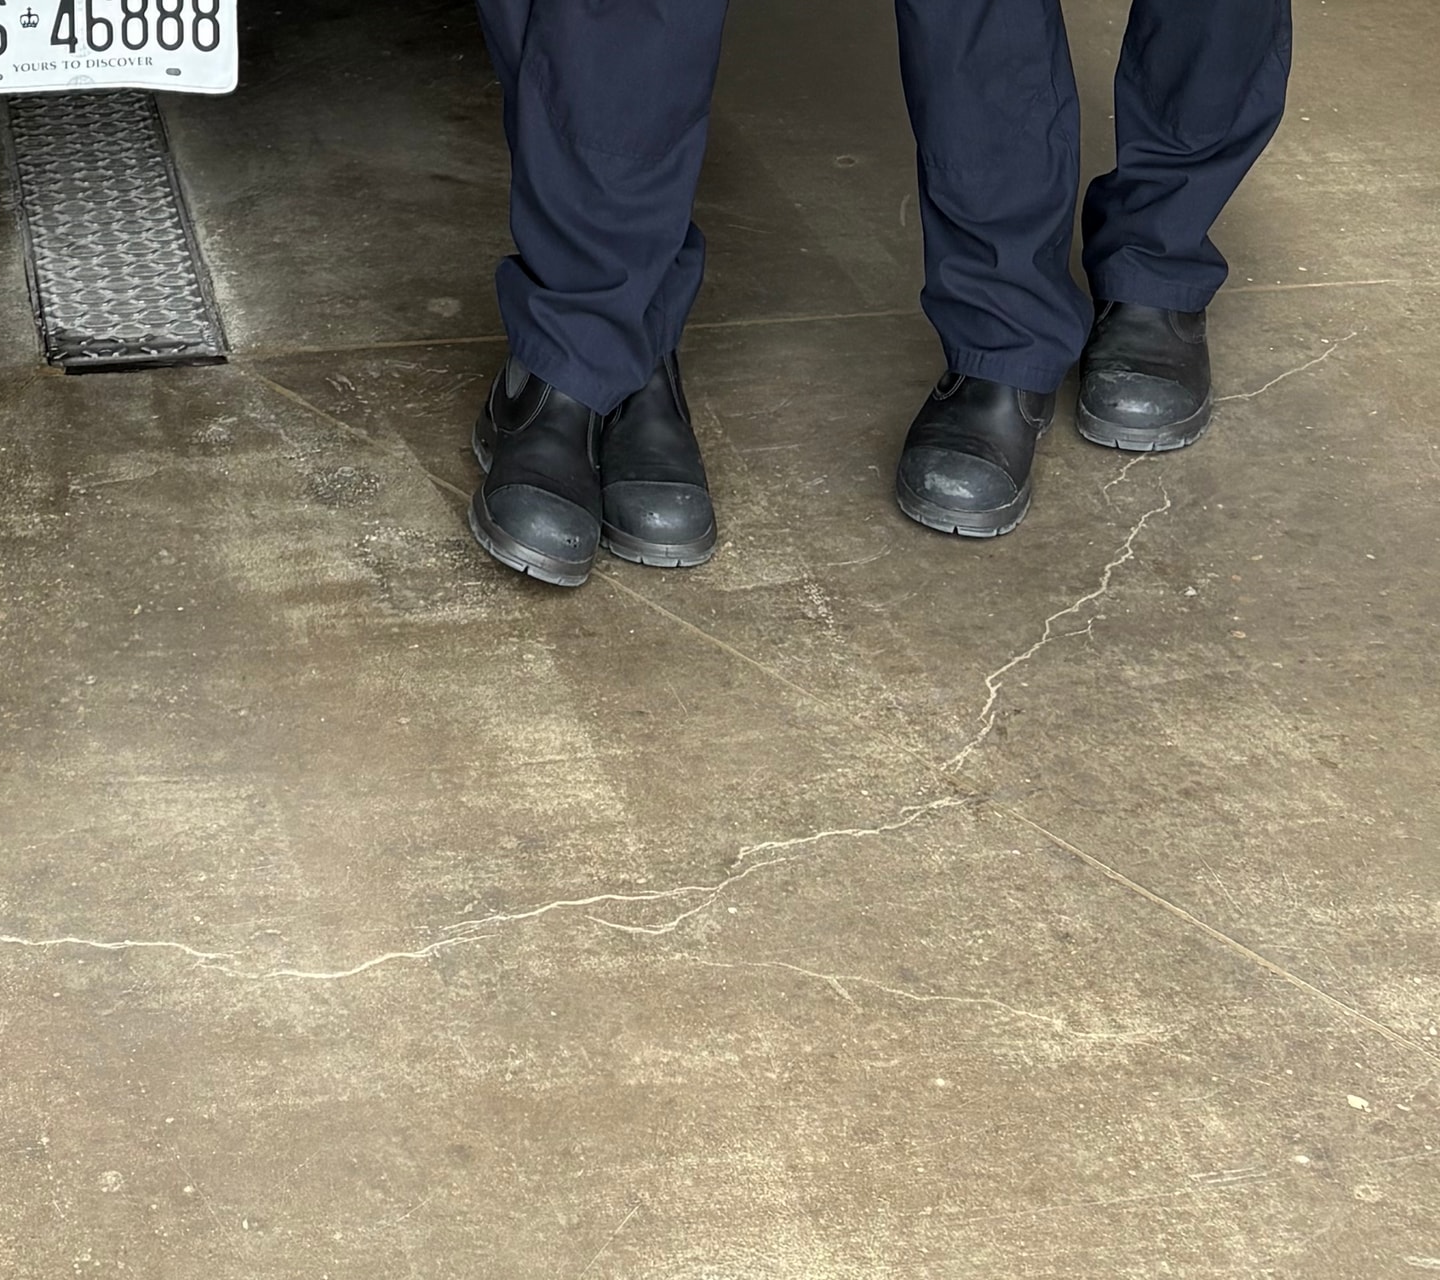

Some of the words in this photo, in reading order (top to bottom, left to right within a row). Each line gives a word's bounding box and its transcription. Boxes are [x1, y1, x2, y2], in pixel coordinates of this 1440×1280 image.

[13, 60, 57, 73] YOURS
[62, 59, 81, 70] TO
[86, 56, 154, 69] DISCOVER
